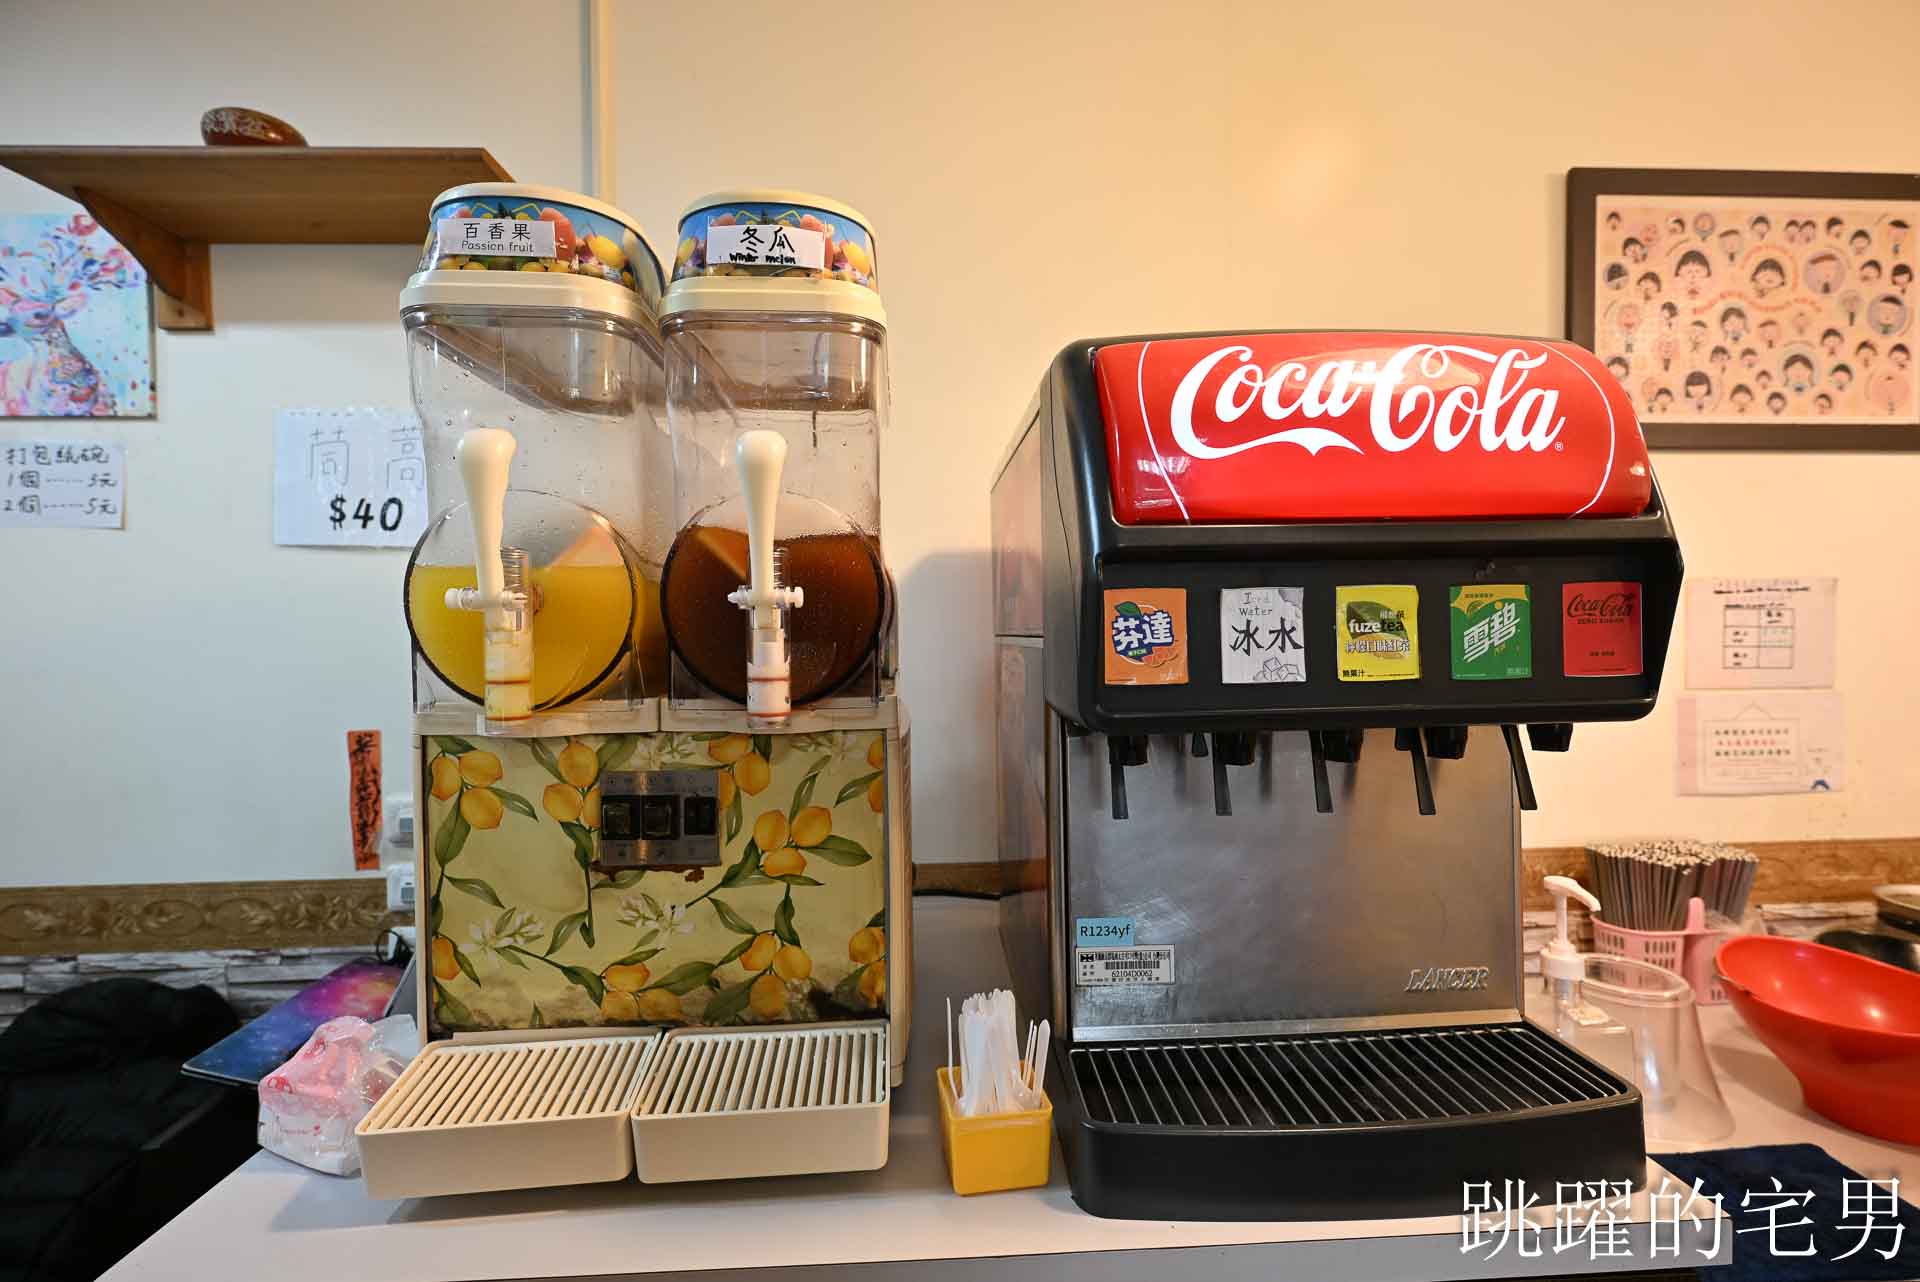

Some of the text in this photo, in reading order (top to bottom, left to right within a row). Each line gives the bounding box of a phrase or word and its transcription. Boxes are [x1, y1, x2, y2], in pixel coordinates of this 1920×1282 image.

[461, 240, 535, 253] Passion fruit
[463, 222, 532, 241] 百香果
[740, 226, 795, 253] 冬瓜
[1170, 344, 1566, 459] Coca-Cola
[329, 493, 403, 531] $40
[1113, 611, 1173, 652] 芬達
[1229, 616, 1304, 656] 冰水
[1463, 602, 1520, 663] 雪碧
[1080, 924, 1131, 938] R1234yf
